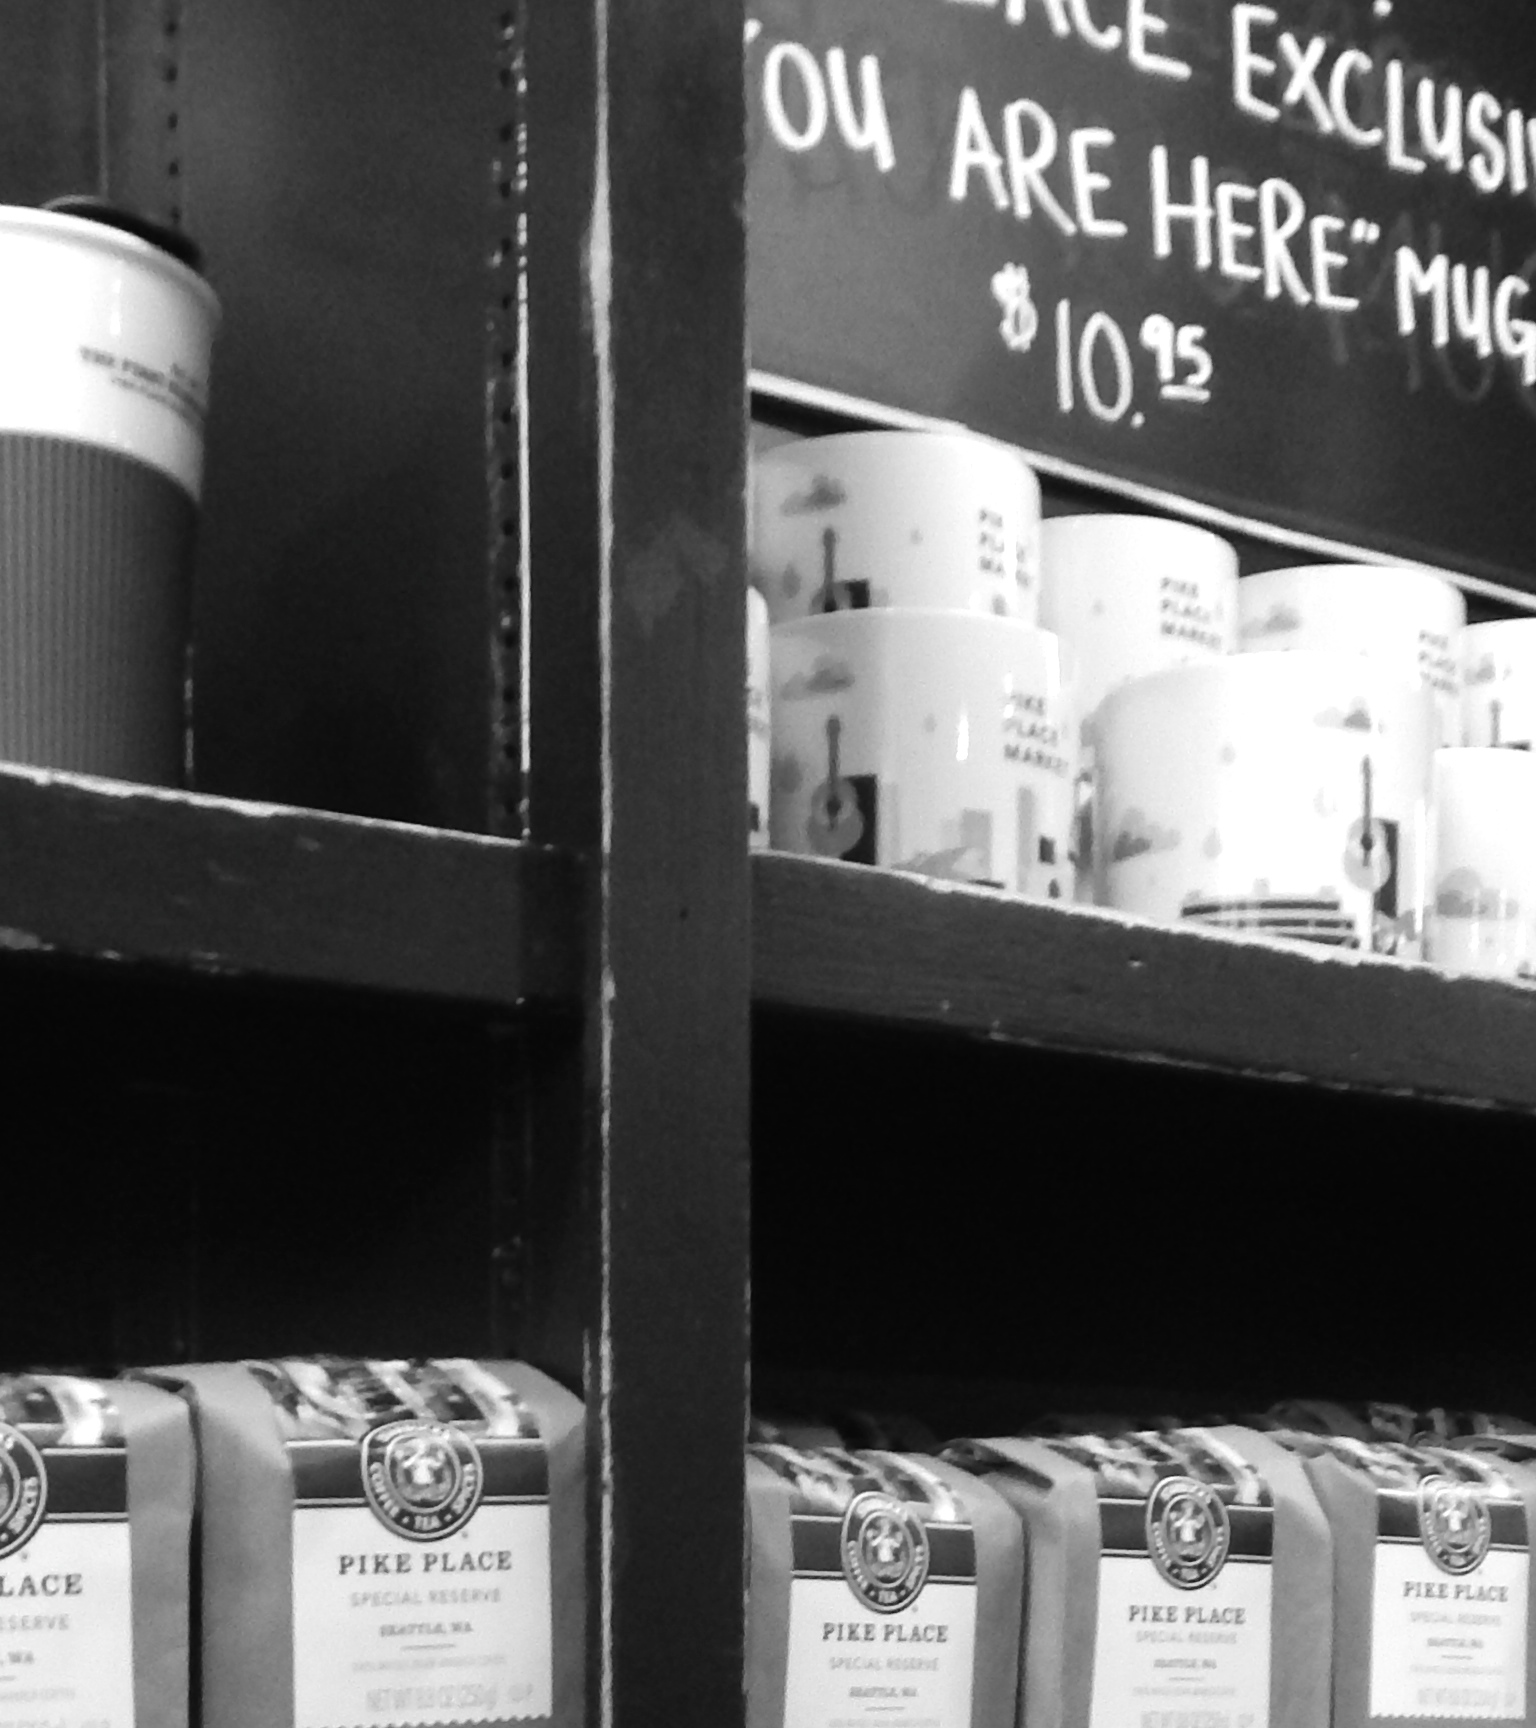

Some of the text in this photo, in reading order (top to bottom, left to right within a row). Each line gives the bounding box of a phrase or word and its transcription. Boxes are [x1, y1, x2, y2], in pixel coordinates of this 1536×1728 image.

[744, 19, 897, 173] OU
[949, 86, 1128, 237] ARE
[338, 1550, 513, 1575] PIKE PLACE
[1403, 1581, 1509, 1603] PIKE PLACE
[1128, 1605, 1247, 1625] PIKE PLACE
[822, 1622, 949, 1643] PIKE PLACE
